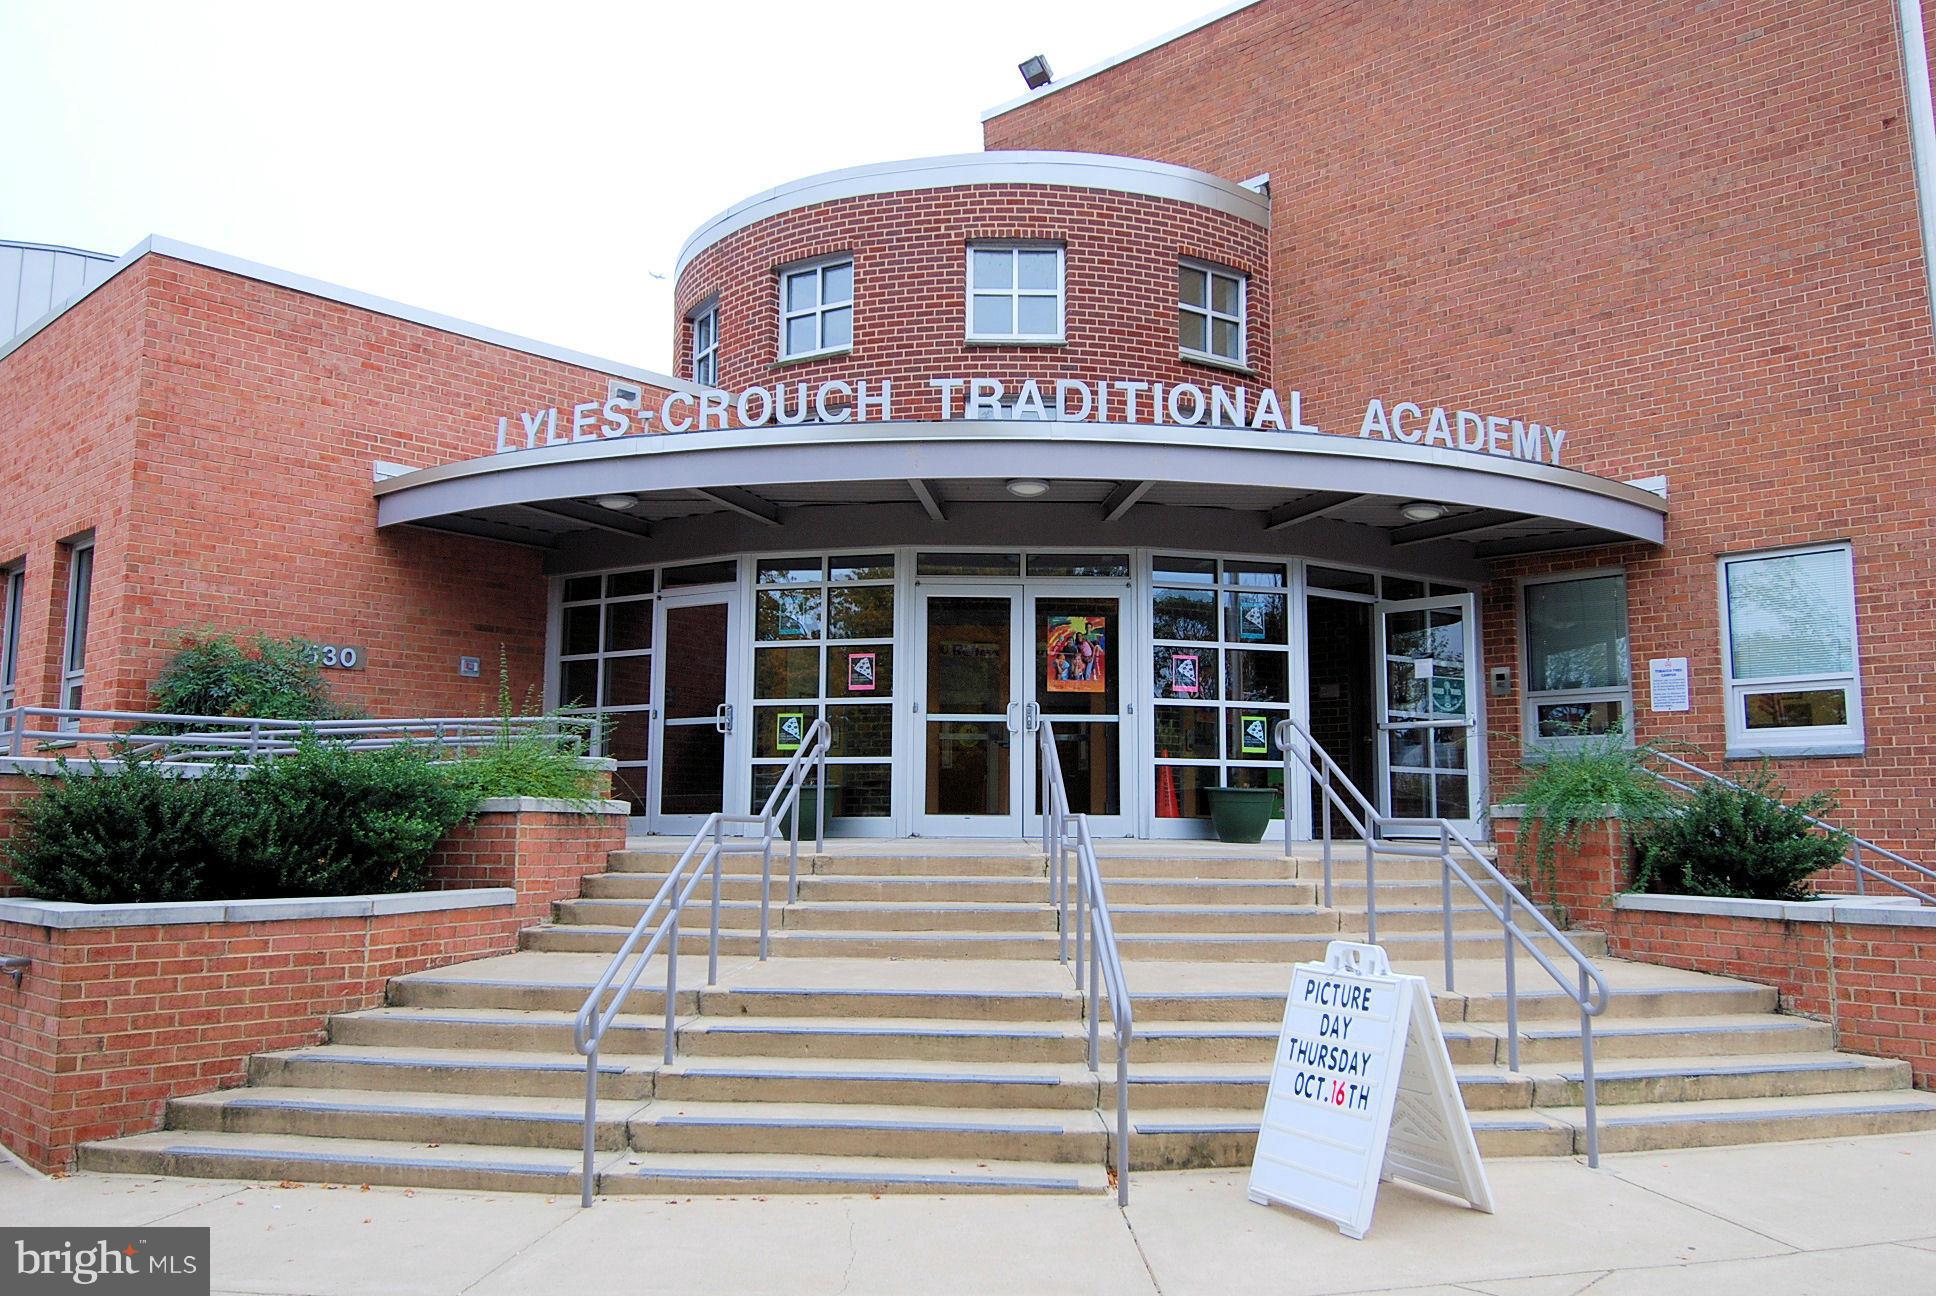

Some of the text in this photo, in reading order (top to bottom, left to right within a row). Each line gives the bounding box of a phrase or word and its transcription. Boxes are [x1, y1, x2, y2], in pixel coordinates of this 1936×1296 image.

[496, 378, 1567, 466] LYLES-CROUCH TRADITIONAL ACADEMY
[1304, 979, 1372, 1011] PICTURE
[1319, 1013, 1352, 1040] DAY
[1289, 1037, 1372, 1077] THURSDAY
